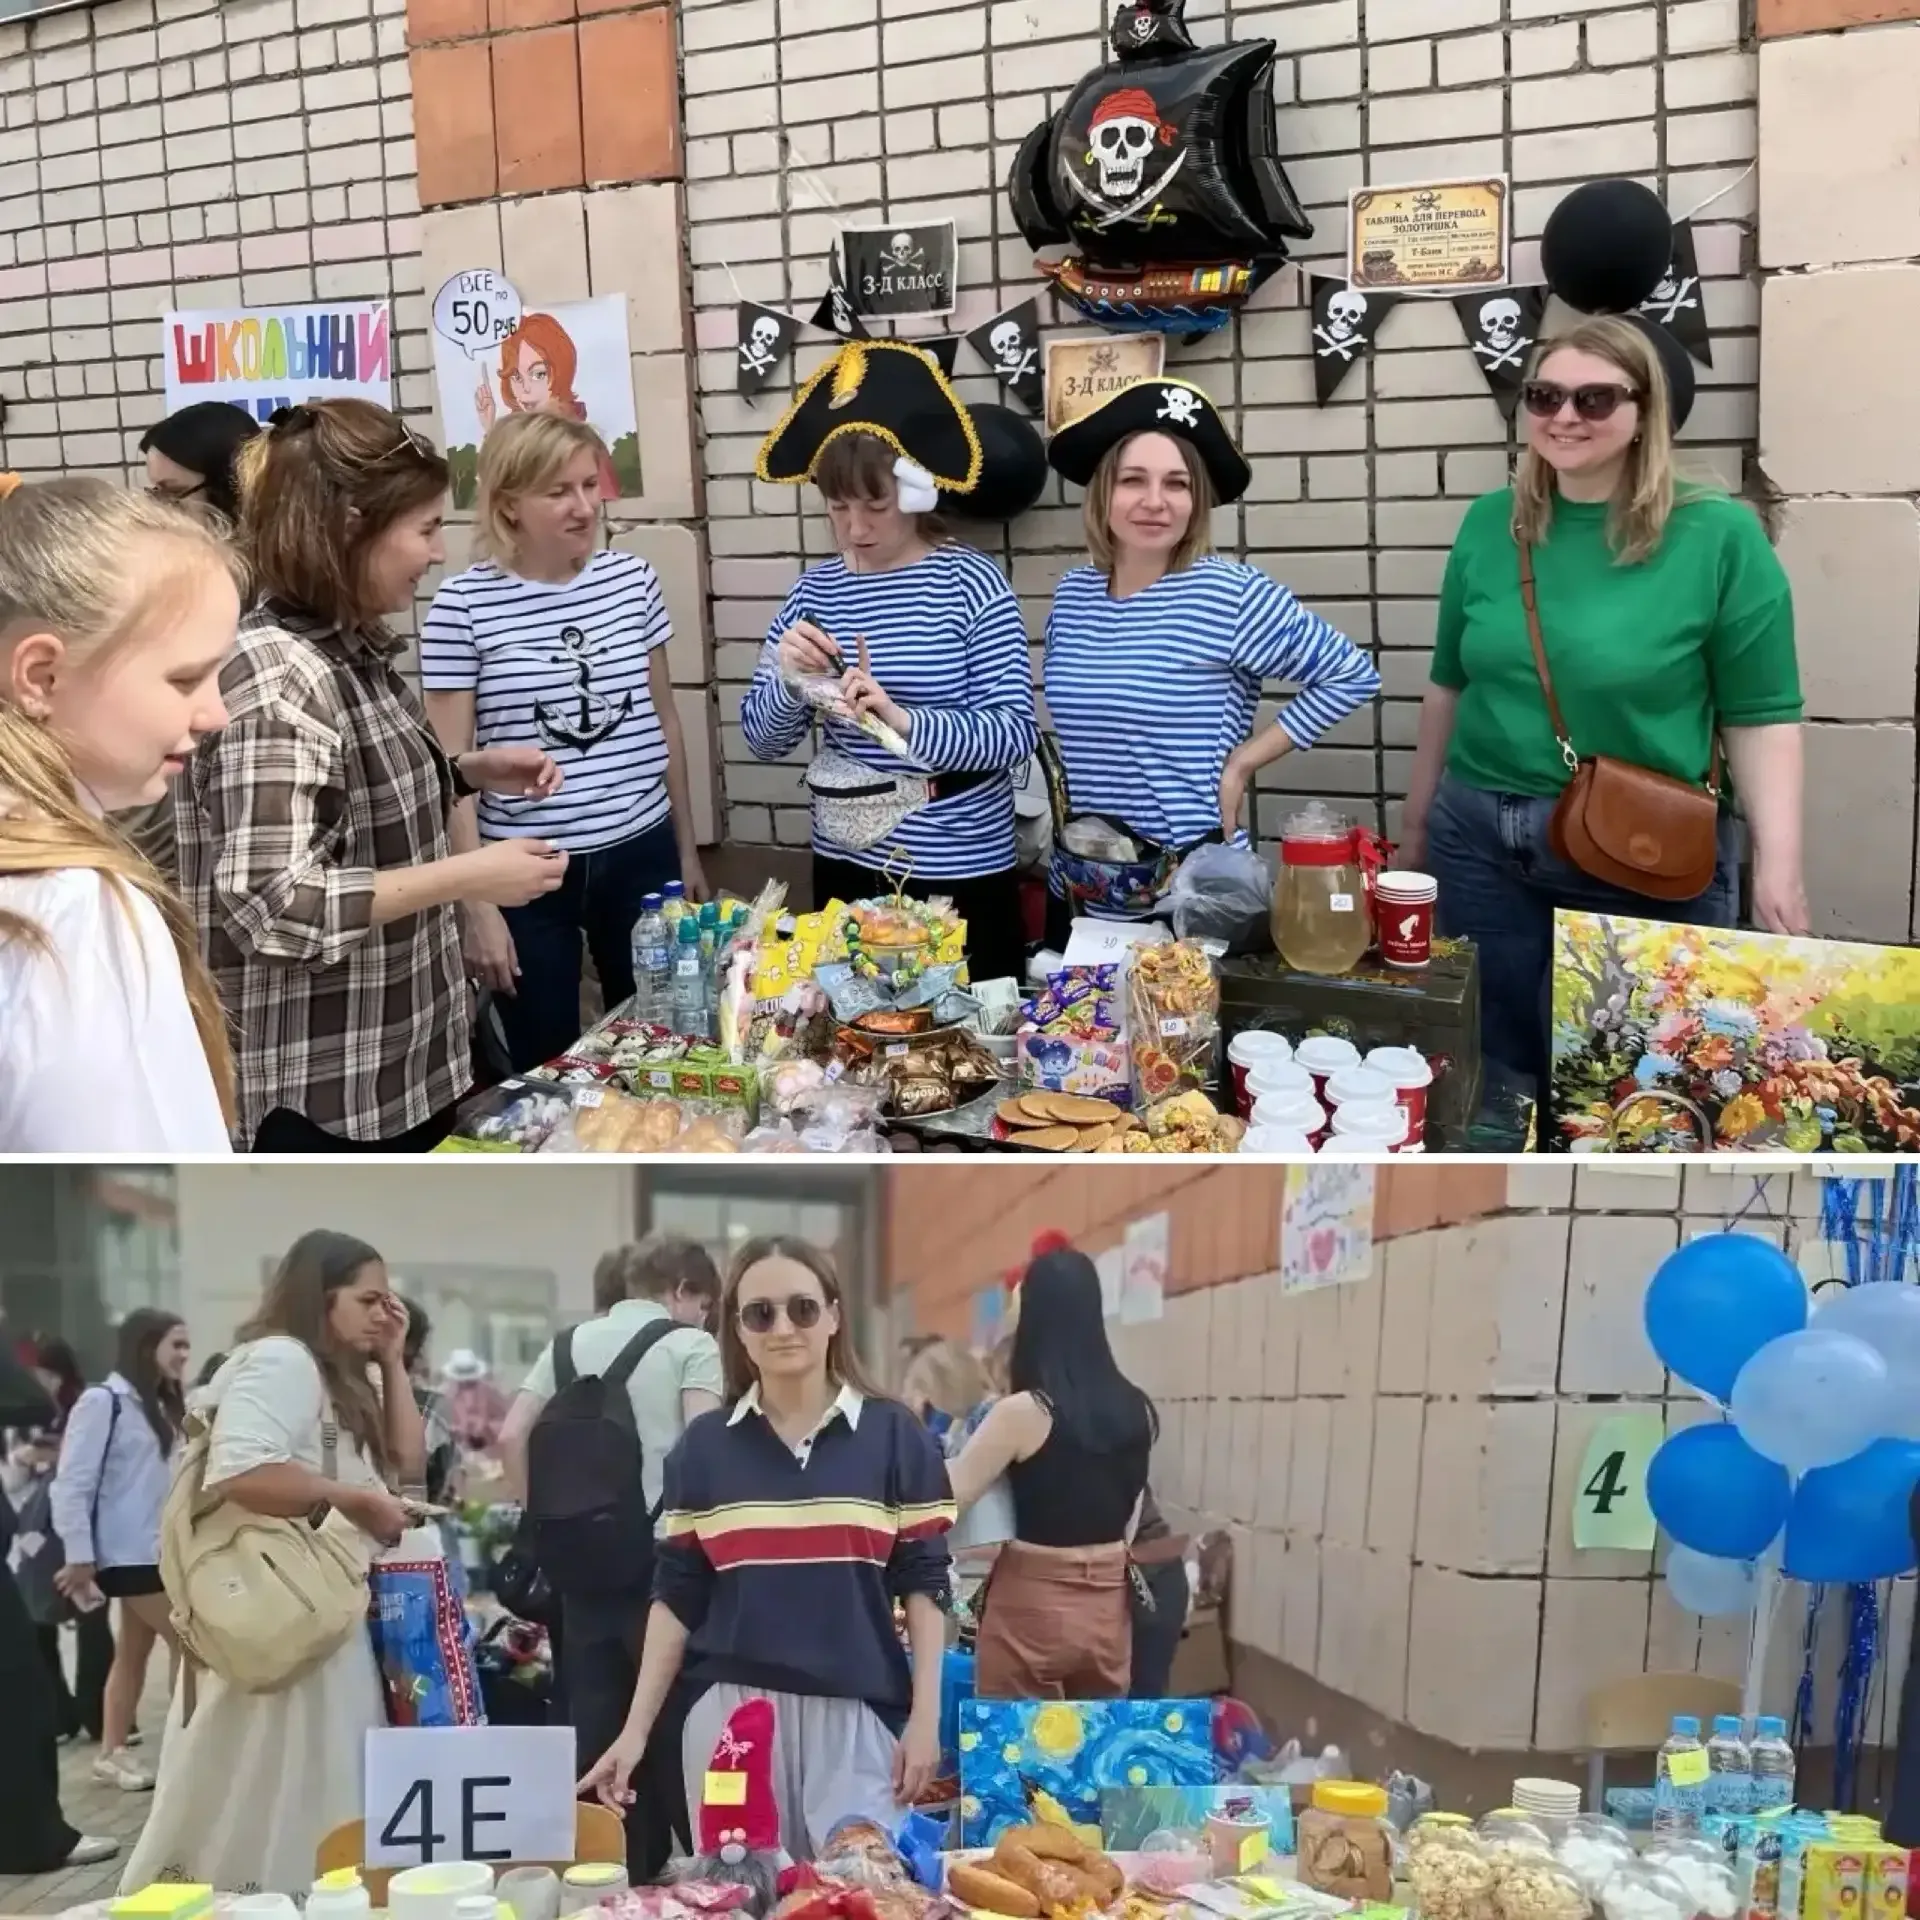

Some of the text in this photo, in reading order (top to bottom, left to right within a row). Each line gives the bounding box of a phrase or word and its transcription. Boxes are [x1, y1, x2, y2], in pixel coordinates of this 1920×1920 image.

[1365, 208, 1487, 226] ТАБЛИЦА ДЛЯ ПЕРЕВОДА
[1392, 220, 1458, 234] ЗОЛОТИШКА
[459, 273, 493, 294] ВСЕ
[897, 272, 944, 291] КЛАСС
[453, 300, 489, 337] 50
[173, 304, 389, 384] ШКОЛЬНЫЙ
[1583, 1450, 1629, 1513] 4
